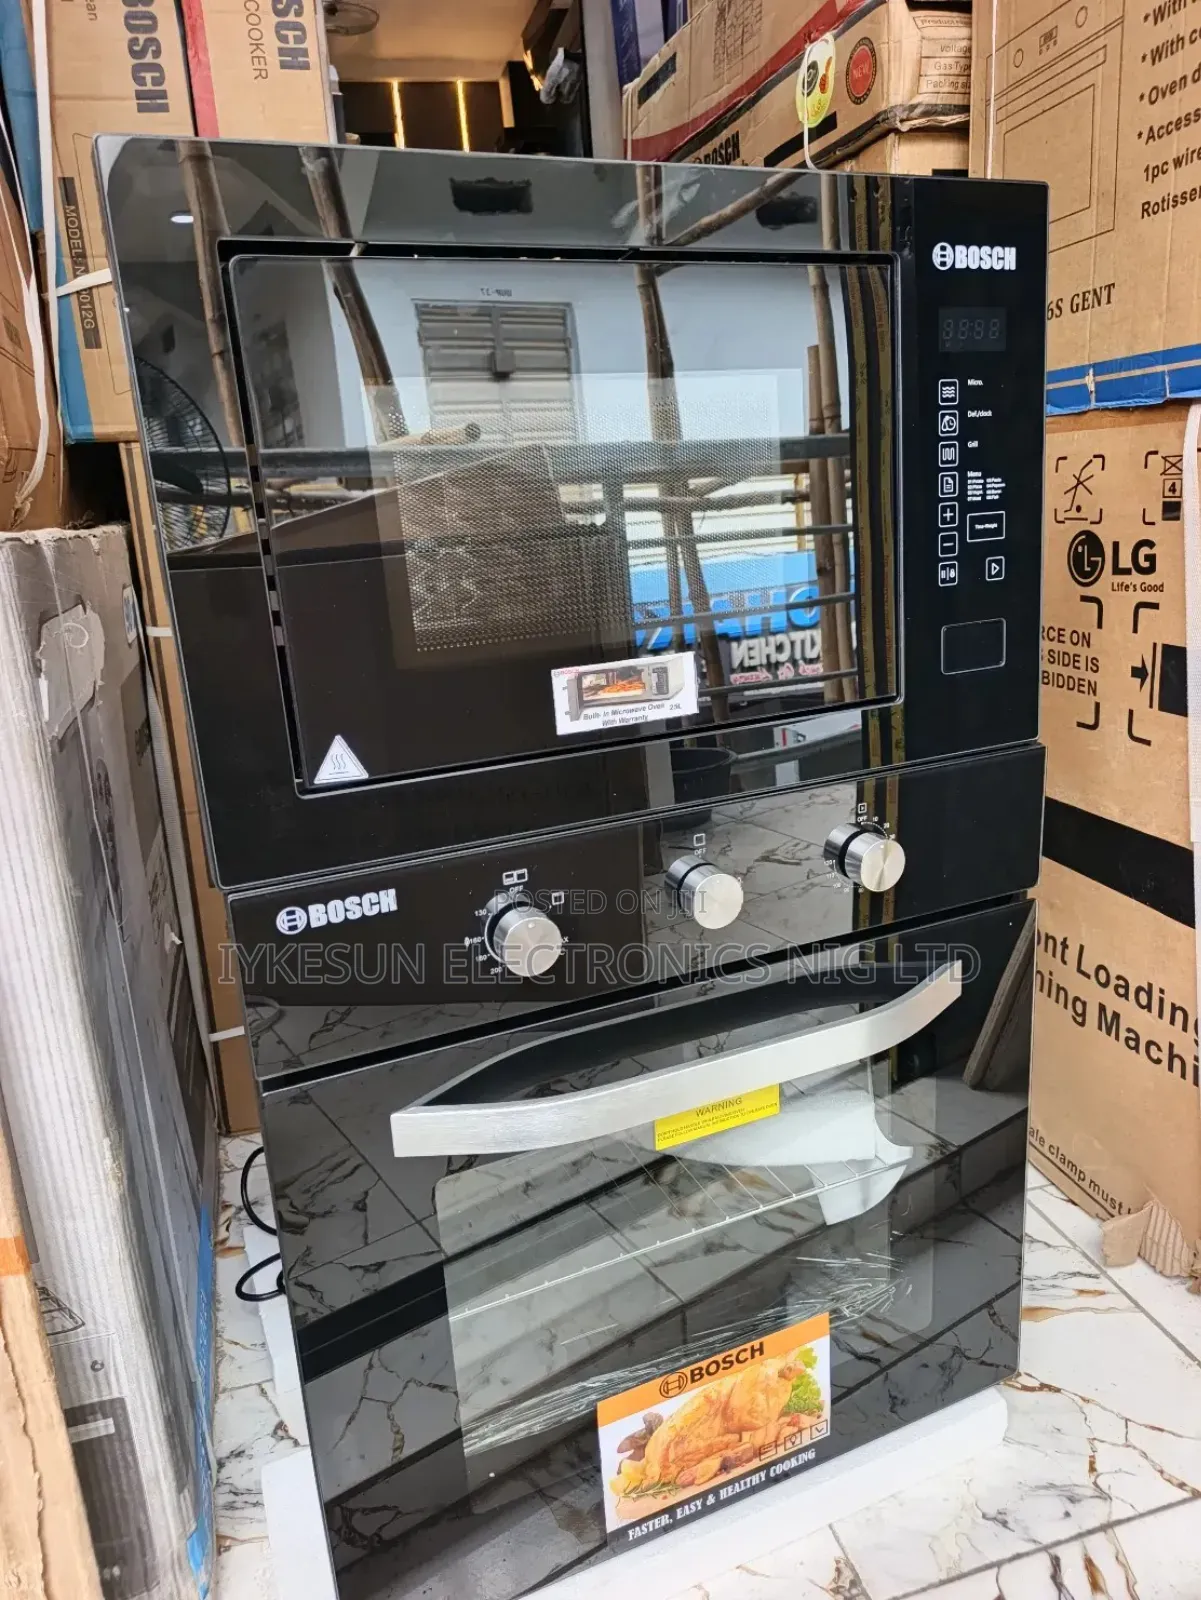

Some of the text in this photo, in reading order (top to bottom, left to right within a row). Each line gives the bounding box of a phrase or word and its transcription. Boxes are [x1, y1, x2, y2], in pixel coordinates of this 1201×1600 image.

[85, 0, 98, 21] an
[244, 0, 268, 81] COOKER
[1143, 159, 1169, 184] 1pc
[65, 204, 85, 264] MODEL:
[955, 245, 1017, 271] BOSCH
[1070, 282, 1116, 316] GENT
[1168, 481, 1178, 495] 4
[1112, 538, 1157, 576] LG
[1111, 581, 1165, 594] Life's Good
[1070, 629, 1092, 649] ON
[1047, 648, 1100, 674] SIDE IS
[1041, 670, 1098, 697] BIDDEN
[308, 888, 398, 929] BOSCH
[1076, 943, 1199, 1048] Loadin
[695, 1097, 743, 1117] WARNING
[1048, 1145, 1086, 1182] clamp
[1088, 1178, 1123, 1216] must
[689, 1342, 765, 1385] BOSCH
[627, 1448, 816, 1541] FASTER, EASY & HEALTHY COOKING
